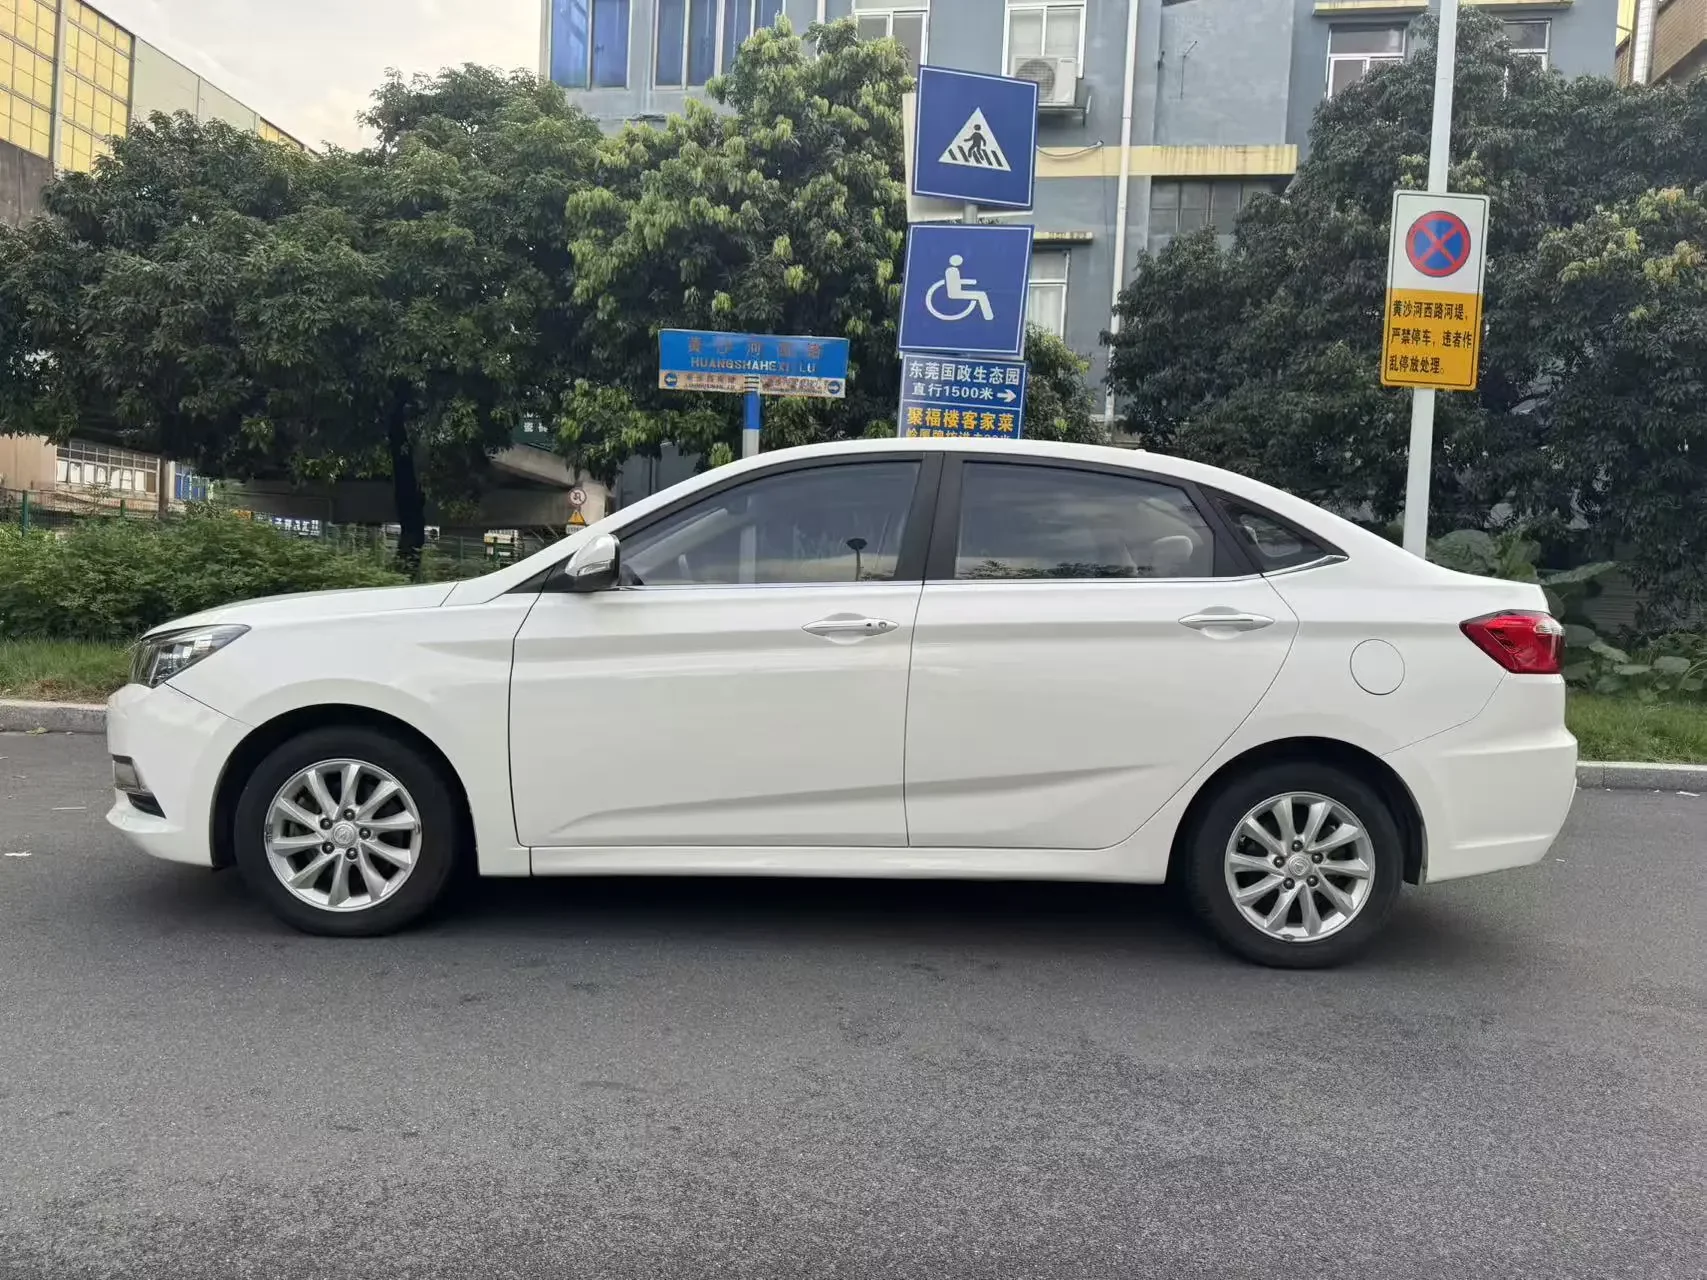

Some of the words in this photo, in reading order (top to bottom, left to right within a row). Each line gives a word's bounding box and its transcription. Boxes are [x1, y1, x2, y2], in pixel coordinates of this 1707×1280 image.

[799, 362, 817, 374] LU
[909, 360, 1020, 386] 东莞国政生态园
[911, 382, 994, 401] 直行1500米
[907, 406, 1015, 433] 聚福楼客家菜
